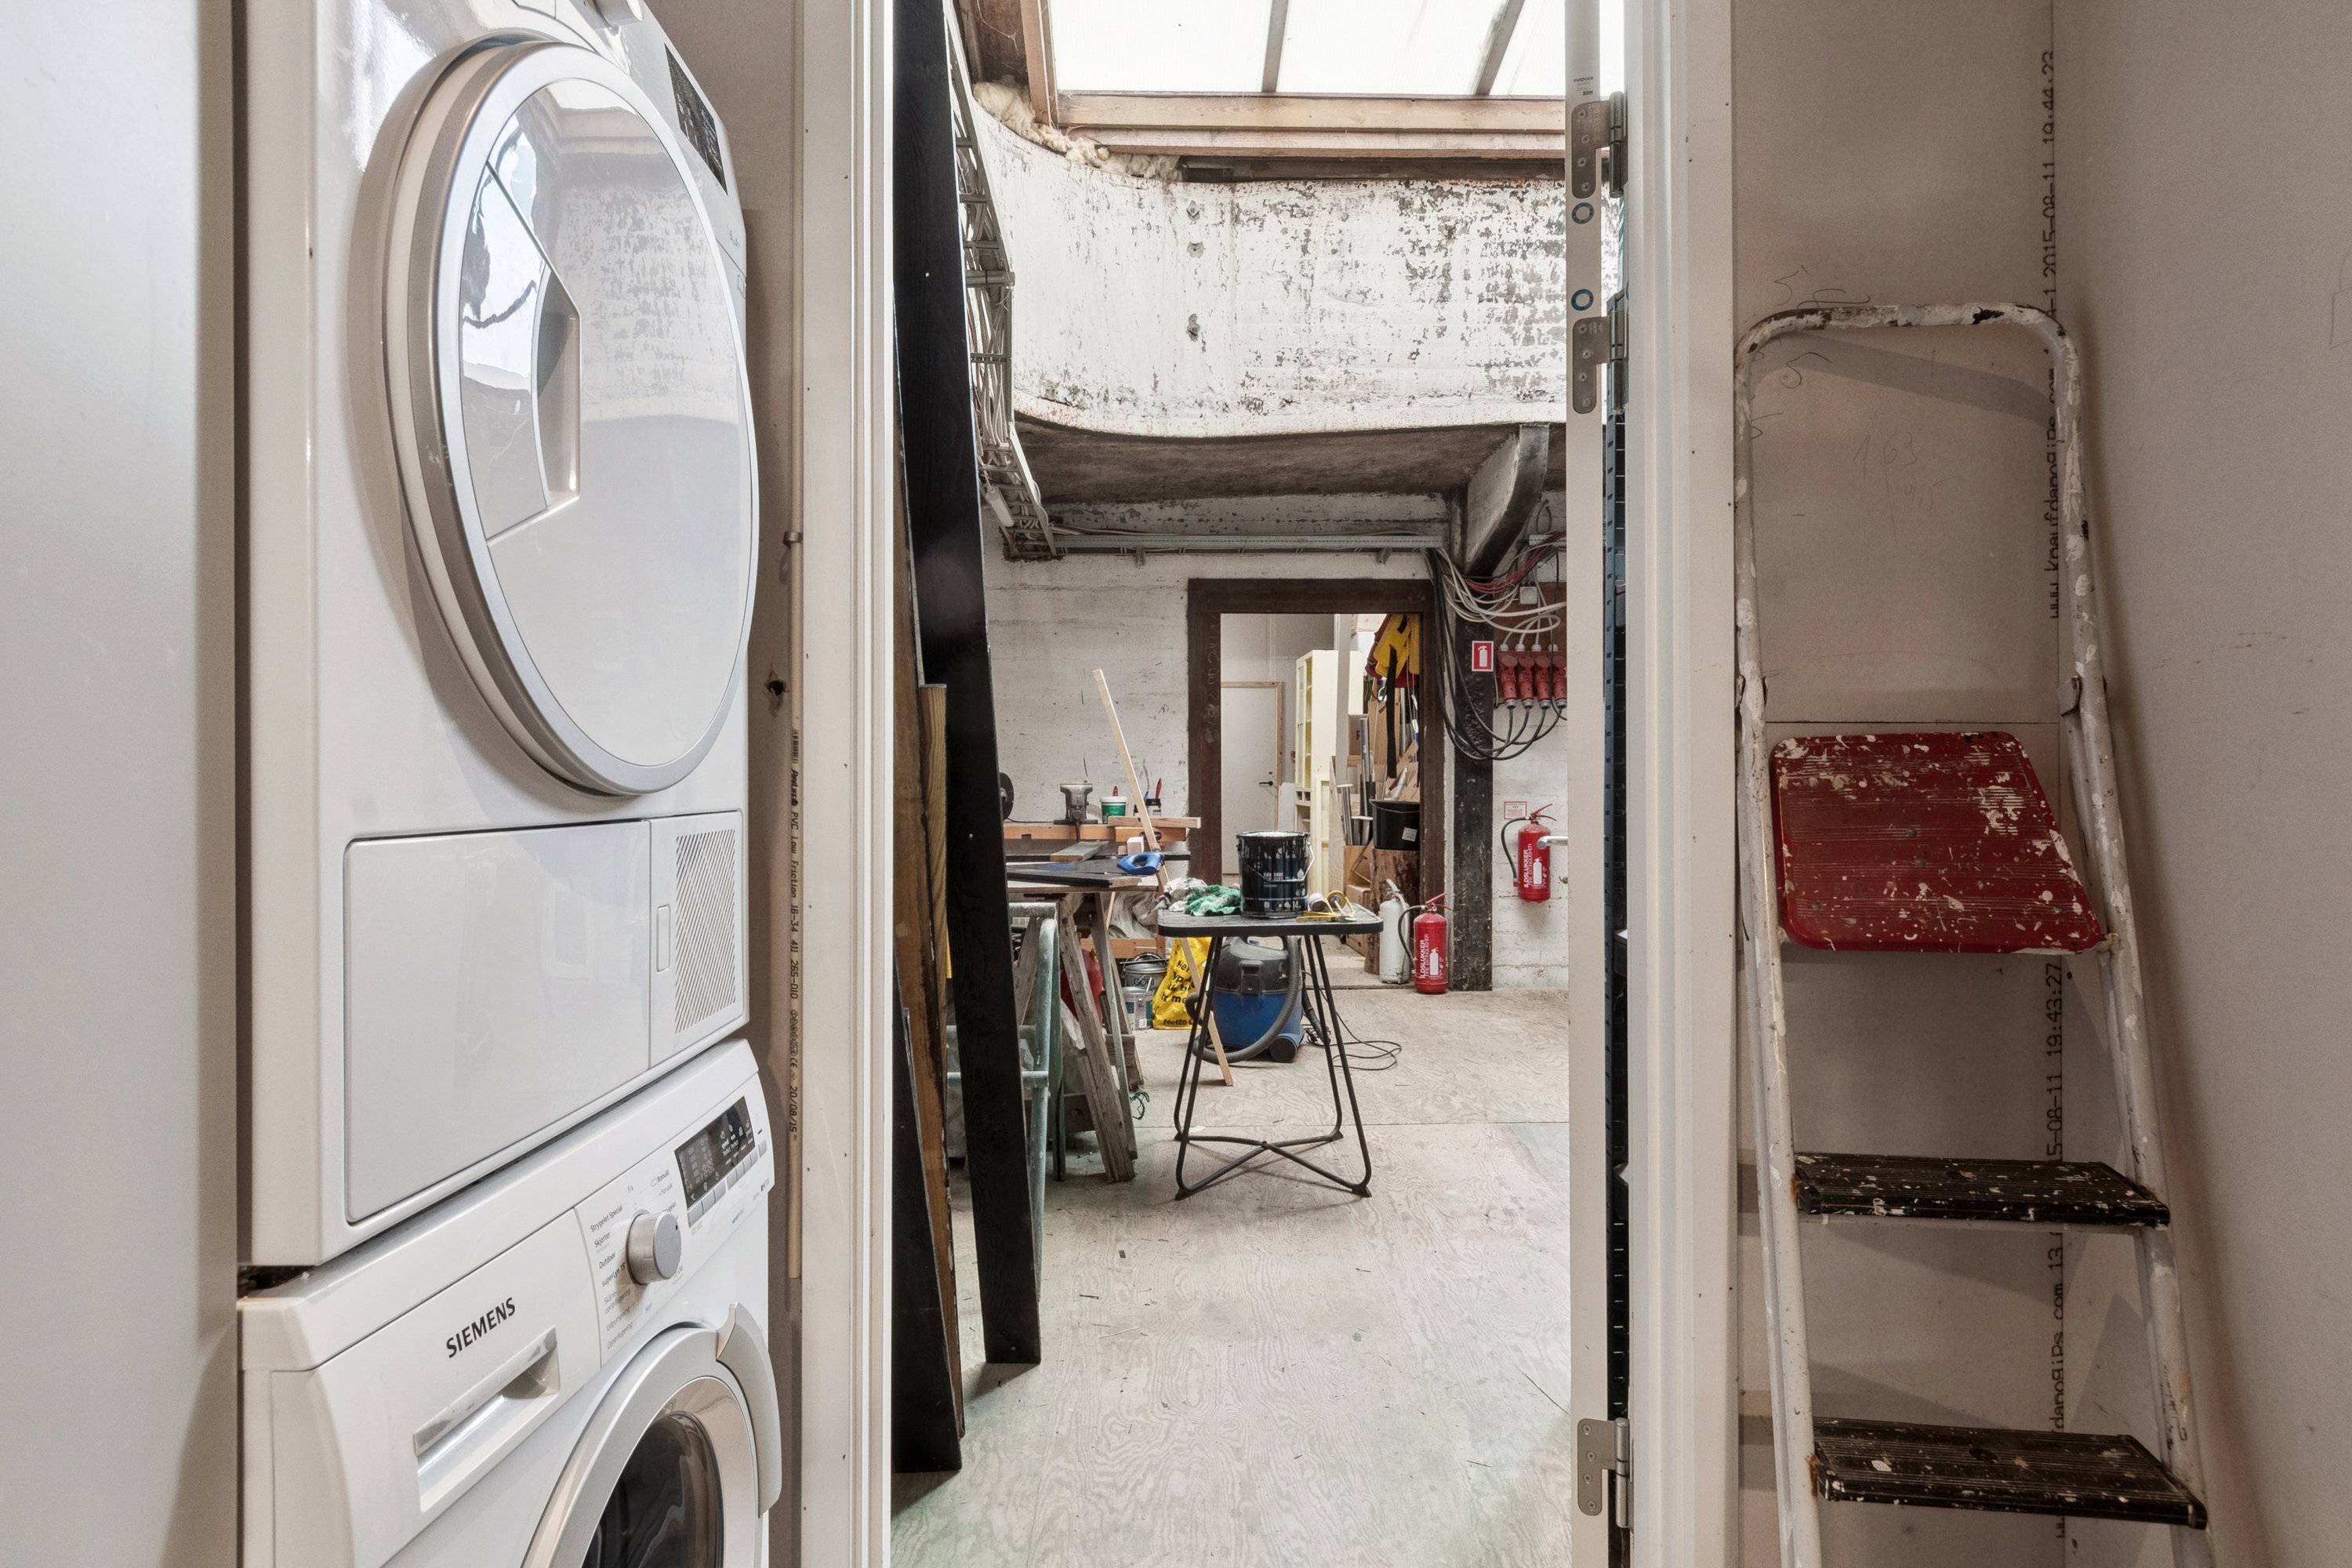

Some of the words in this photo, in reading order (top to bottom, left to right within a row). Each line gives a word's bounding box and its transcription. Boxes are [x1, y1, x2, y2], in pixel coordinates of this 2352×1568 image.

[790, 811, 799, 830] PVC
[790, 836, 799, 854] Low
[790, 859, 799, 898] Friction
[790, 904, 799, 932] 16-34
[2045, 963, 2062, 1056] 19:43:27
[789, 1085, 798, 1133] 20/08/15
[599, 1252, 615, 1269] Outdoor
[446, 1297, 516, 1359] SIEMENS
